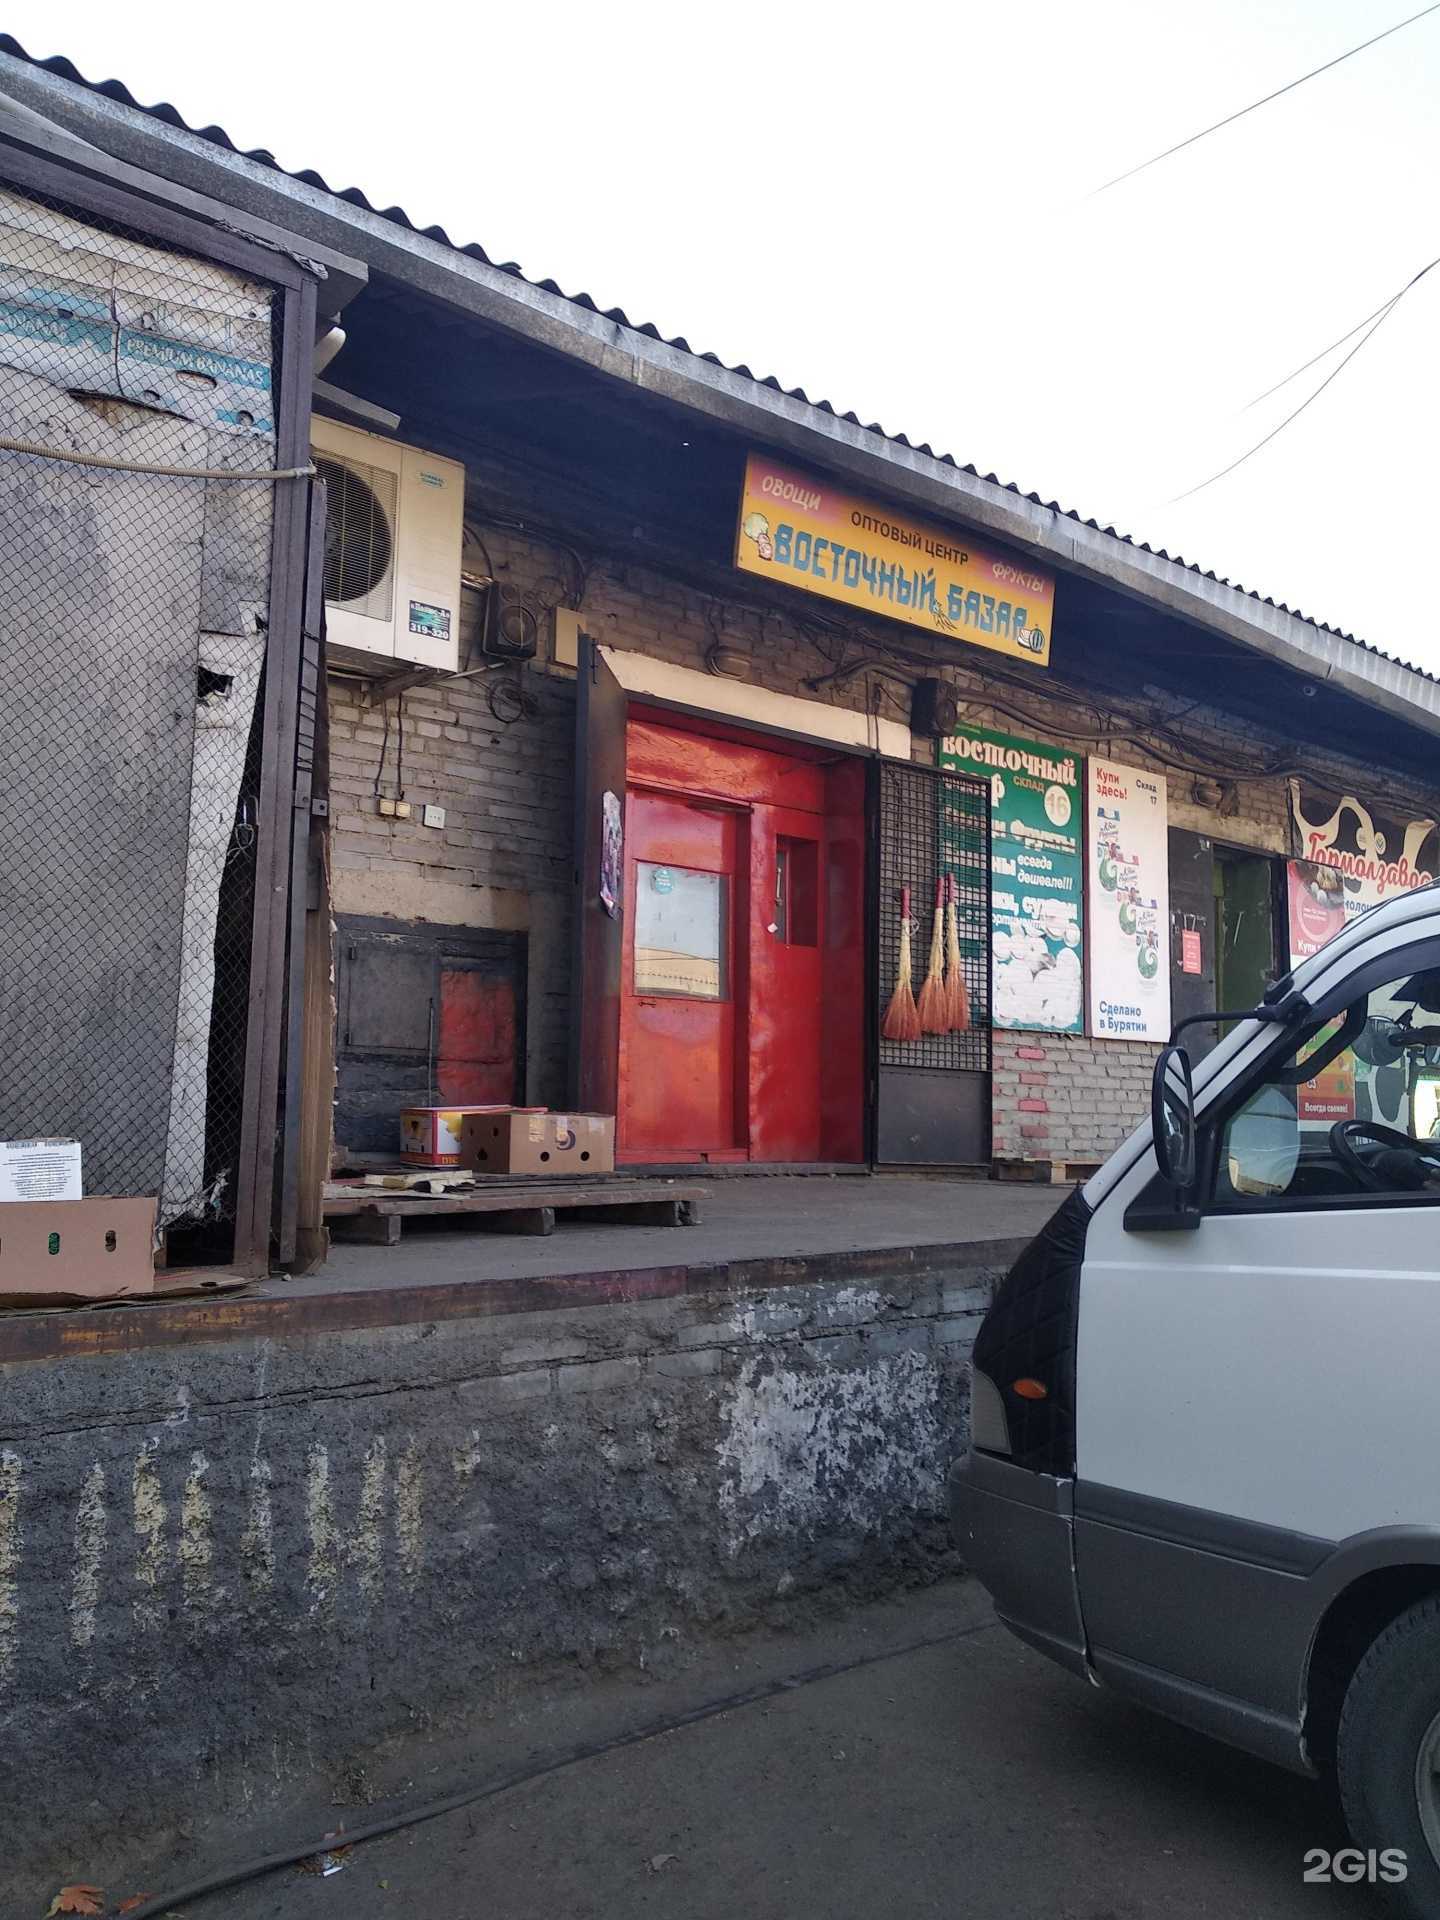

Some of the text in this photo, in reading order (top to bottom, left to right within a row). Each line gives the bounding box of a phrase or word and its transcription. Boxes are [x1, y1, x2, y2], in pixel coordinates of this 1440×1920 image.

[127, 338, 264, 385] PREMIUM BANANAS
[762, 475, 822, 510] ОВОЩИ
[851, 511, 969, 566] ОПТОВЫЙ ЦЕНТР
[774, 523, 1028, 641] ВОСТОЧНЫЙ БАЗАР
[992, 561, 1044, 593] ФРУКТЫ
[1096, 767, 1120, 785] Купи
[1096, 783, 1128, 800] здесь!
[1135, 779, 1158, 793] Склад
[1150, 796, 1158, 806] 17
[1099, 1000, 1142, 1017] Сделано
[1099, 1016, 1148, 1034] в Бурятии
[1304, 1101, 1326, 1114] Всегда
